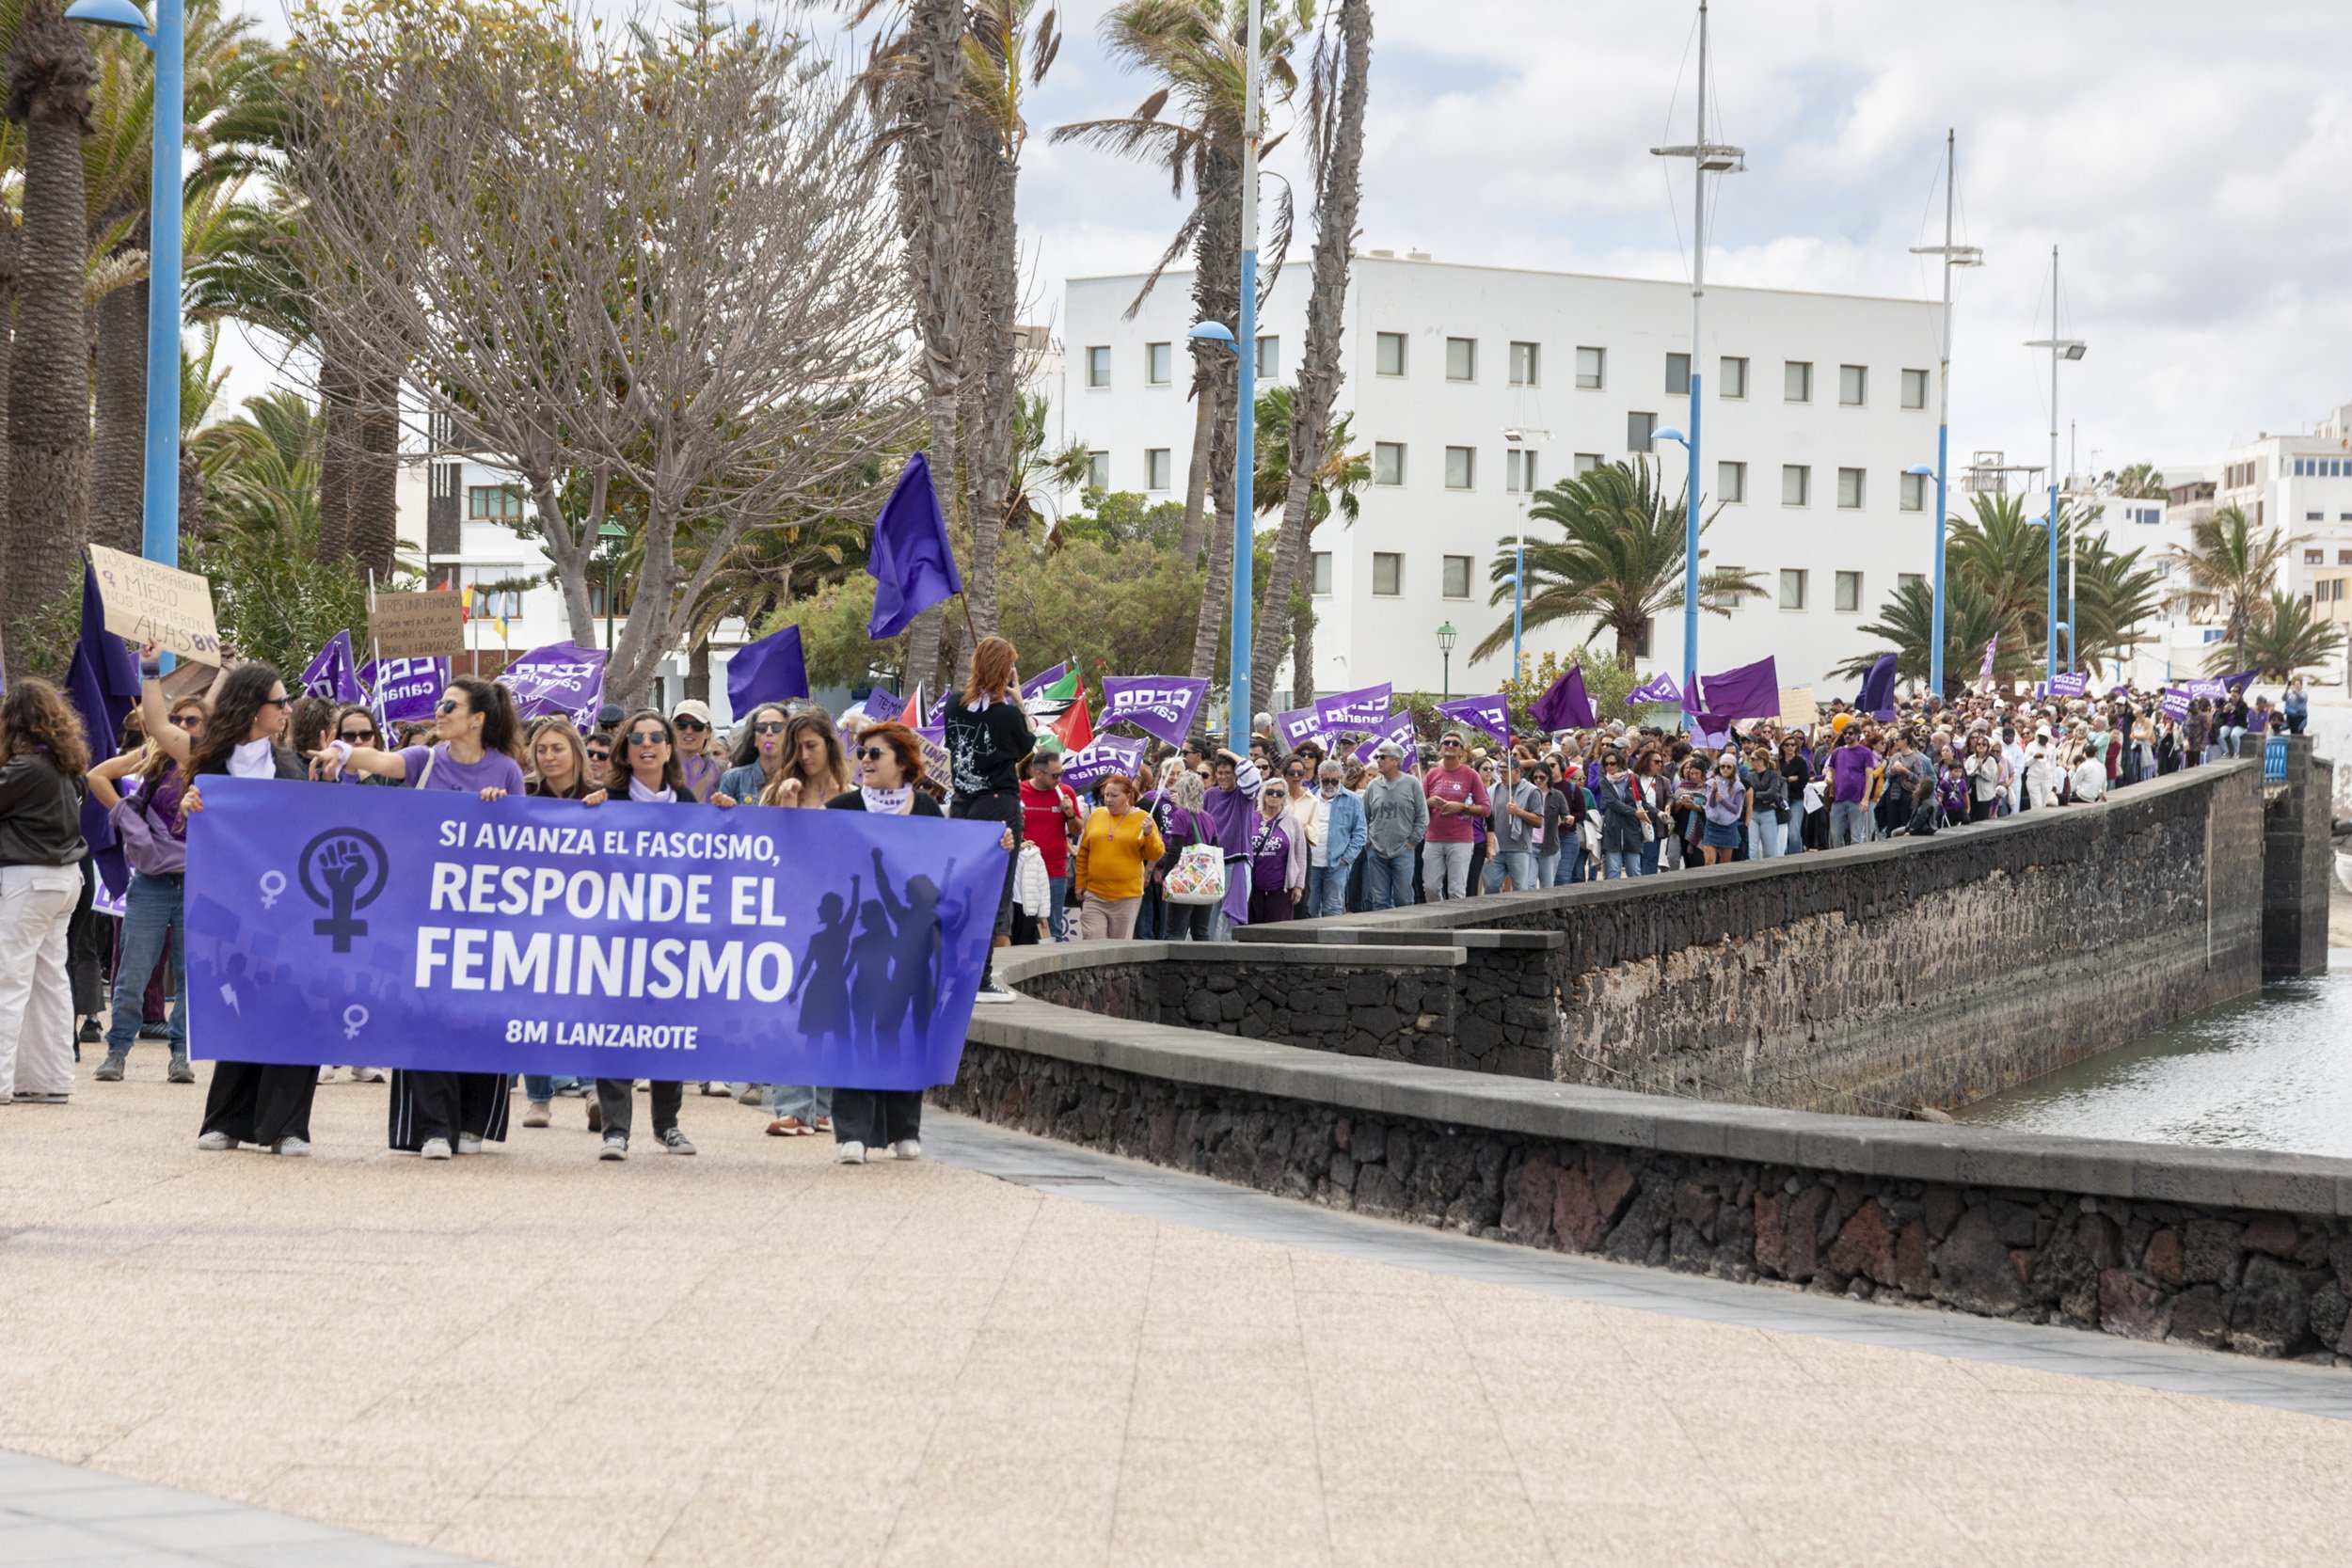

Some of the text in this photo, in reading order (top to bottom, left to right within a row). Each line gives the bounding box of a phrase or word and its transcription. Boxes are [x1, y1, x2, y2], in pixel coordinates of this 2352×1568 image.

[97, 550, 127, 570] NOS
[105, 590, 134, 608] NOS
[125, 575, 178, 607] MIEDO
[134, 615, 220, 653] ALAS 8M
[429, 627, 459, 639] TENGO
[439, 819, 781, 867] SI AVANZA EL FASCISMO,
[429, 862, 787, 927] RESPONDE EL
[415, 926, 794, 1003] FEMINISMO
[505, 1020, 698, 1051] 8M LANZAROTE
